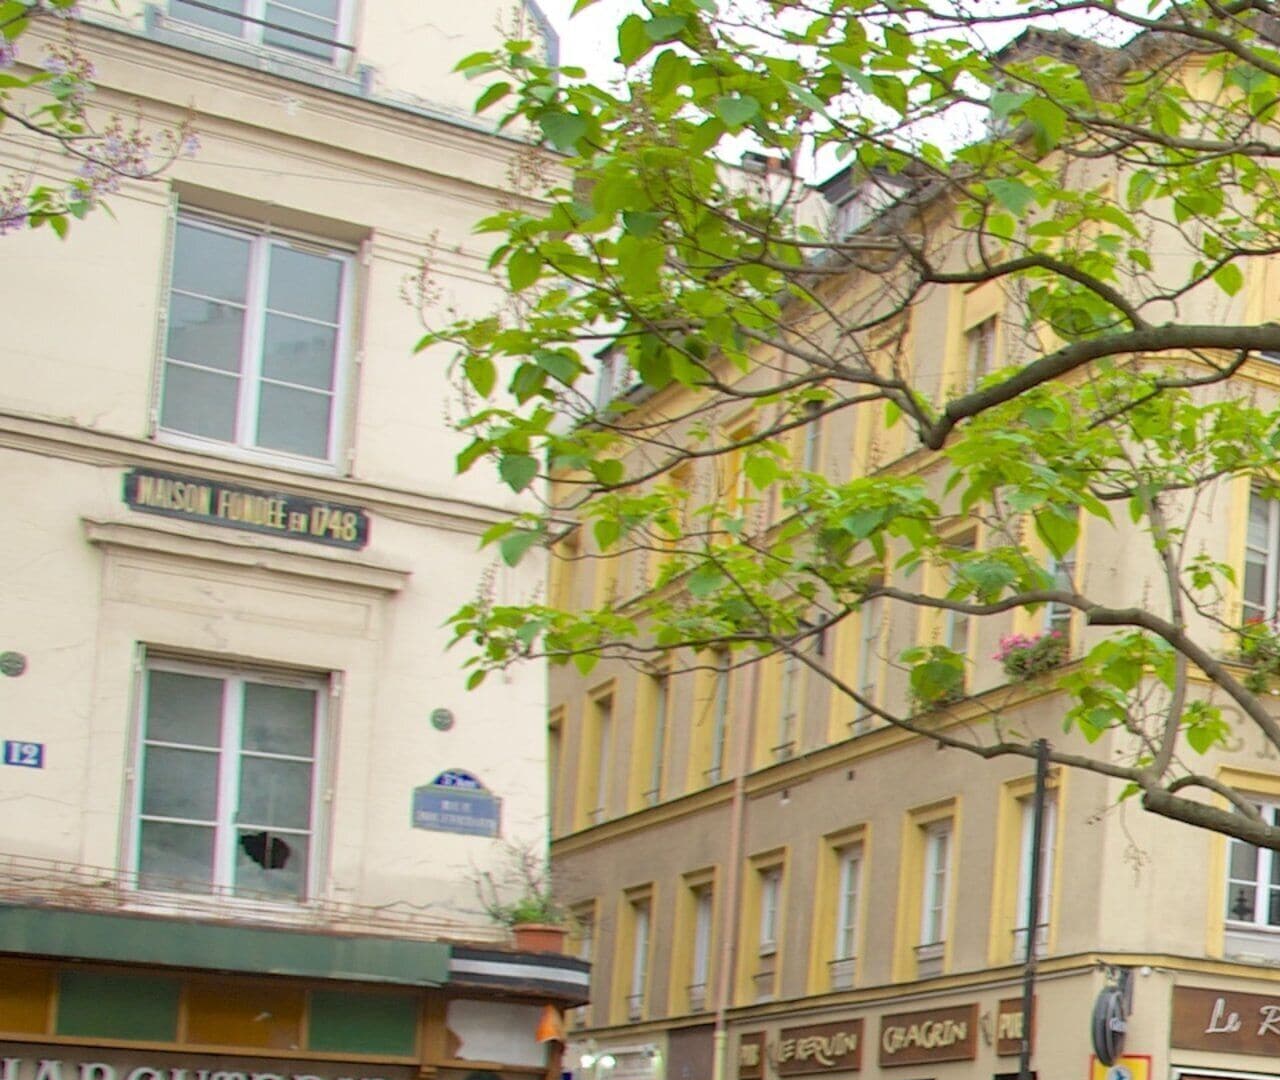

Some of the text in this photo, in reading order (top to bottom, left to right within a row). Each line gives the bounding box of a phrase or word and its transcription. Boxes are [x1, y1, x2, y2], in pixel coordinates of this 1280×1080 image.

[137, 475, 212, 516] MAISON
[312, 507, 358, 541] 1748
[9, 744, 40, 765] 12
[1205, 998, 1241, 1033] Le
[882, 1020, 967, 1053] CHAGRIN
